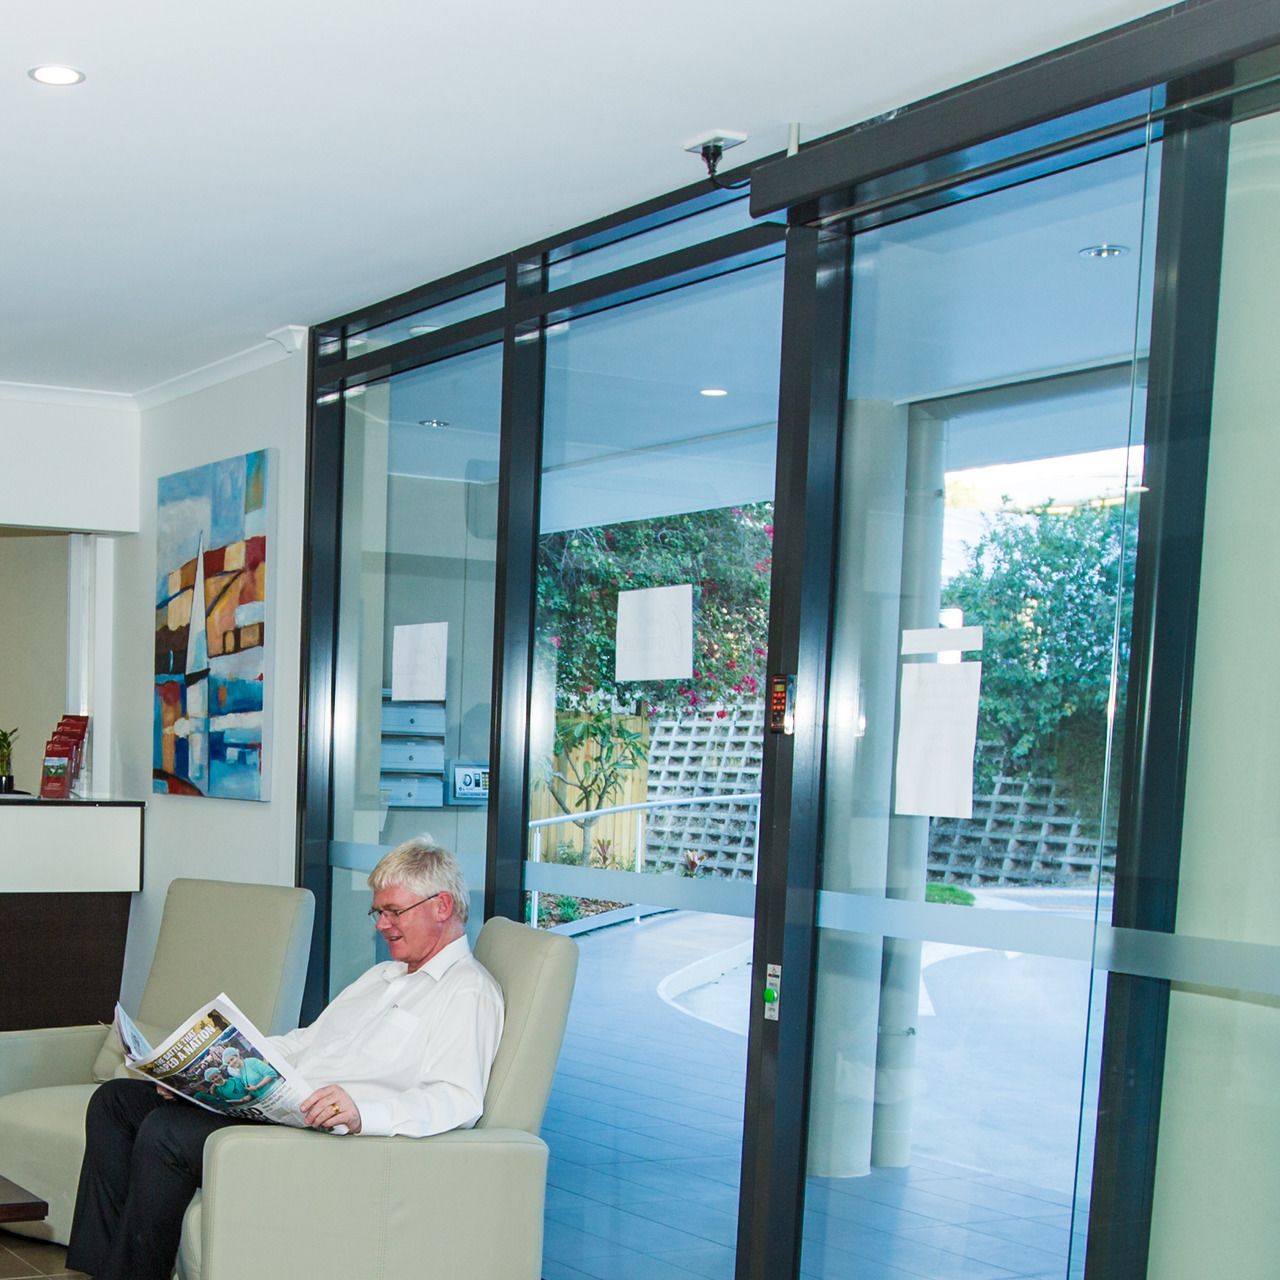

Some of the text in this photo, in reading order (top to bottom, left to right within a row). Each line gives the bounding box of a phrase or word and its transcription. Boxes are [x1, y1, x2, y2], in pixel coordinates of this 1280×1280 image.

[163, 1041, 185, 1060] BATTLE
[182, 1029, 196, 1044] THAT
[177, 1051, 187, 1062] A
[183, 1024, 216, 1055] NATION
